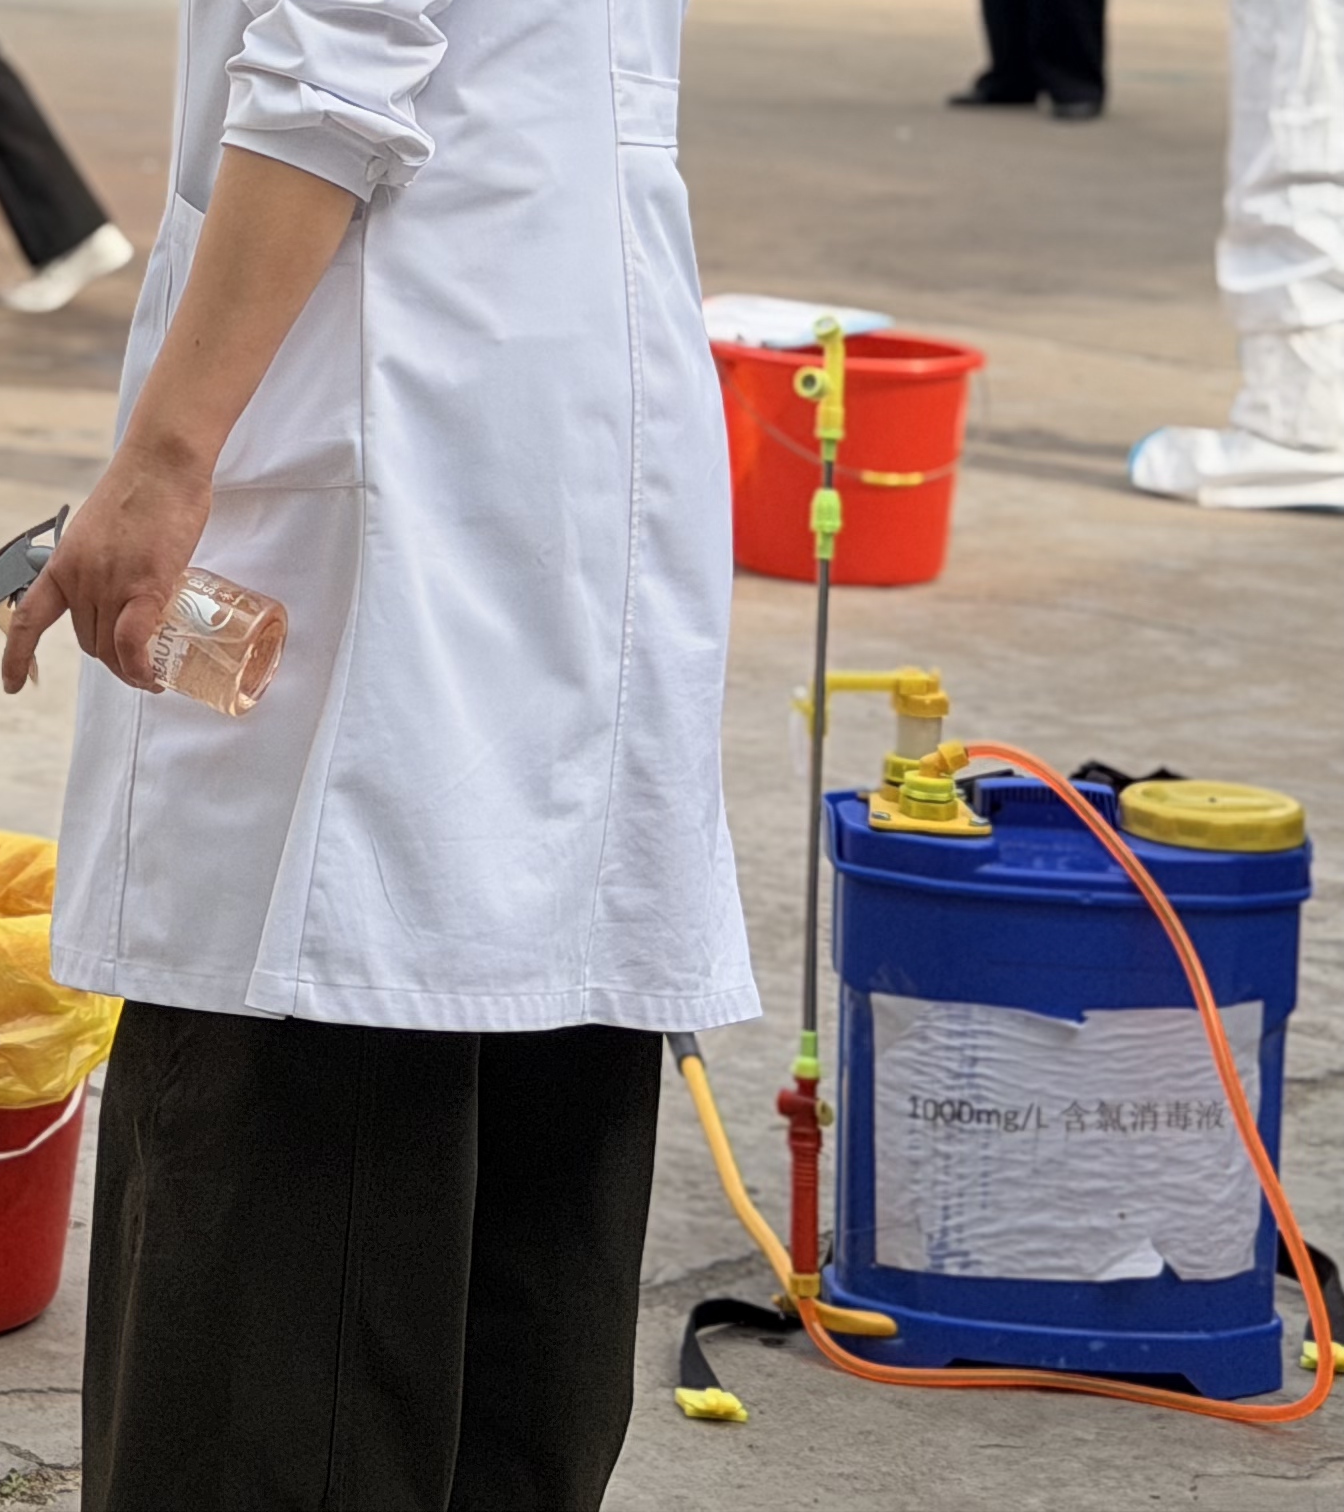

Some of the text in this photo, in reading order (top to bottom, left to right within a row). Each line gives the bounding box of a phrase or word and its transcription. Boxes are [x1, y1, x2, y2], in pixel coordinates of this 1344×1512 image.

[907, 1094, 1225, 1133] 1000mg/L 含氯消毒液
